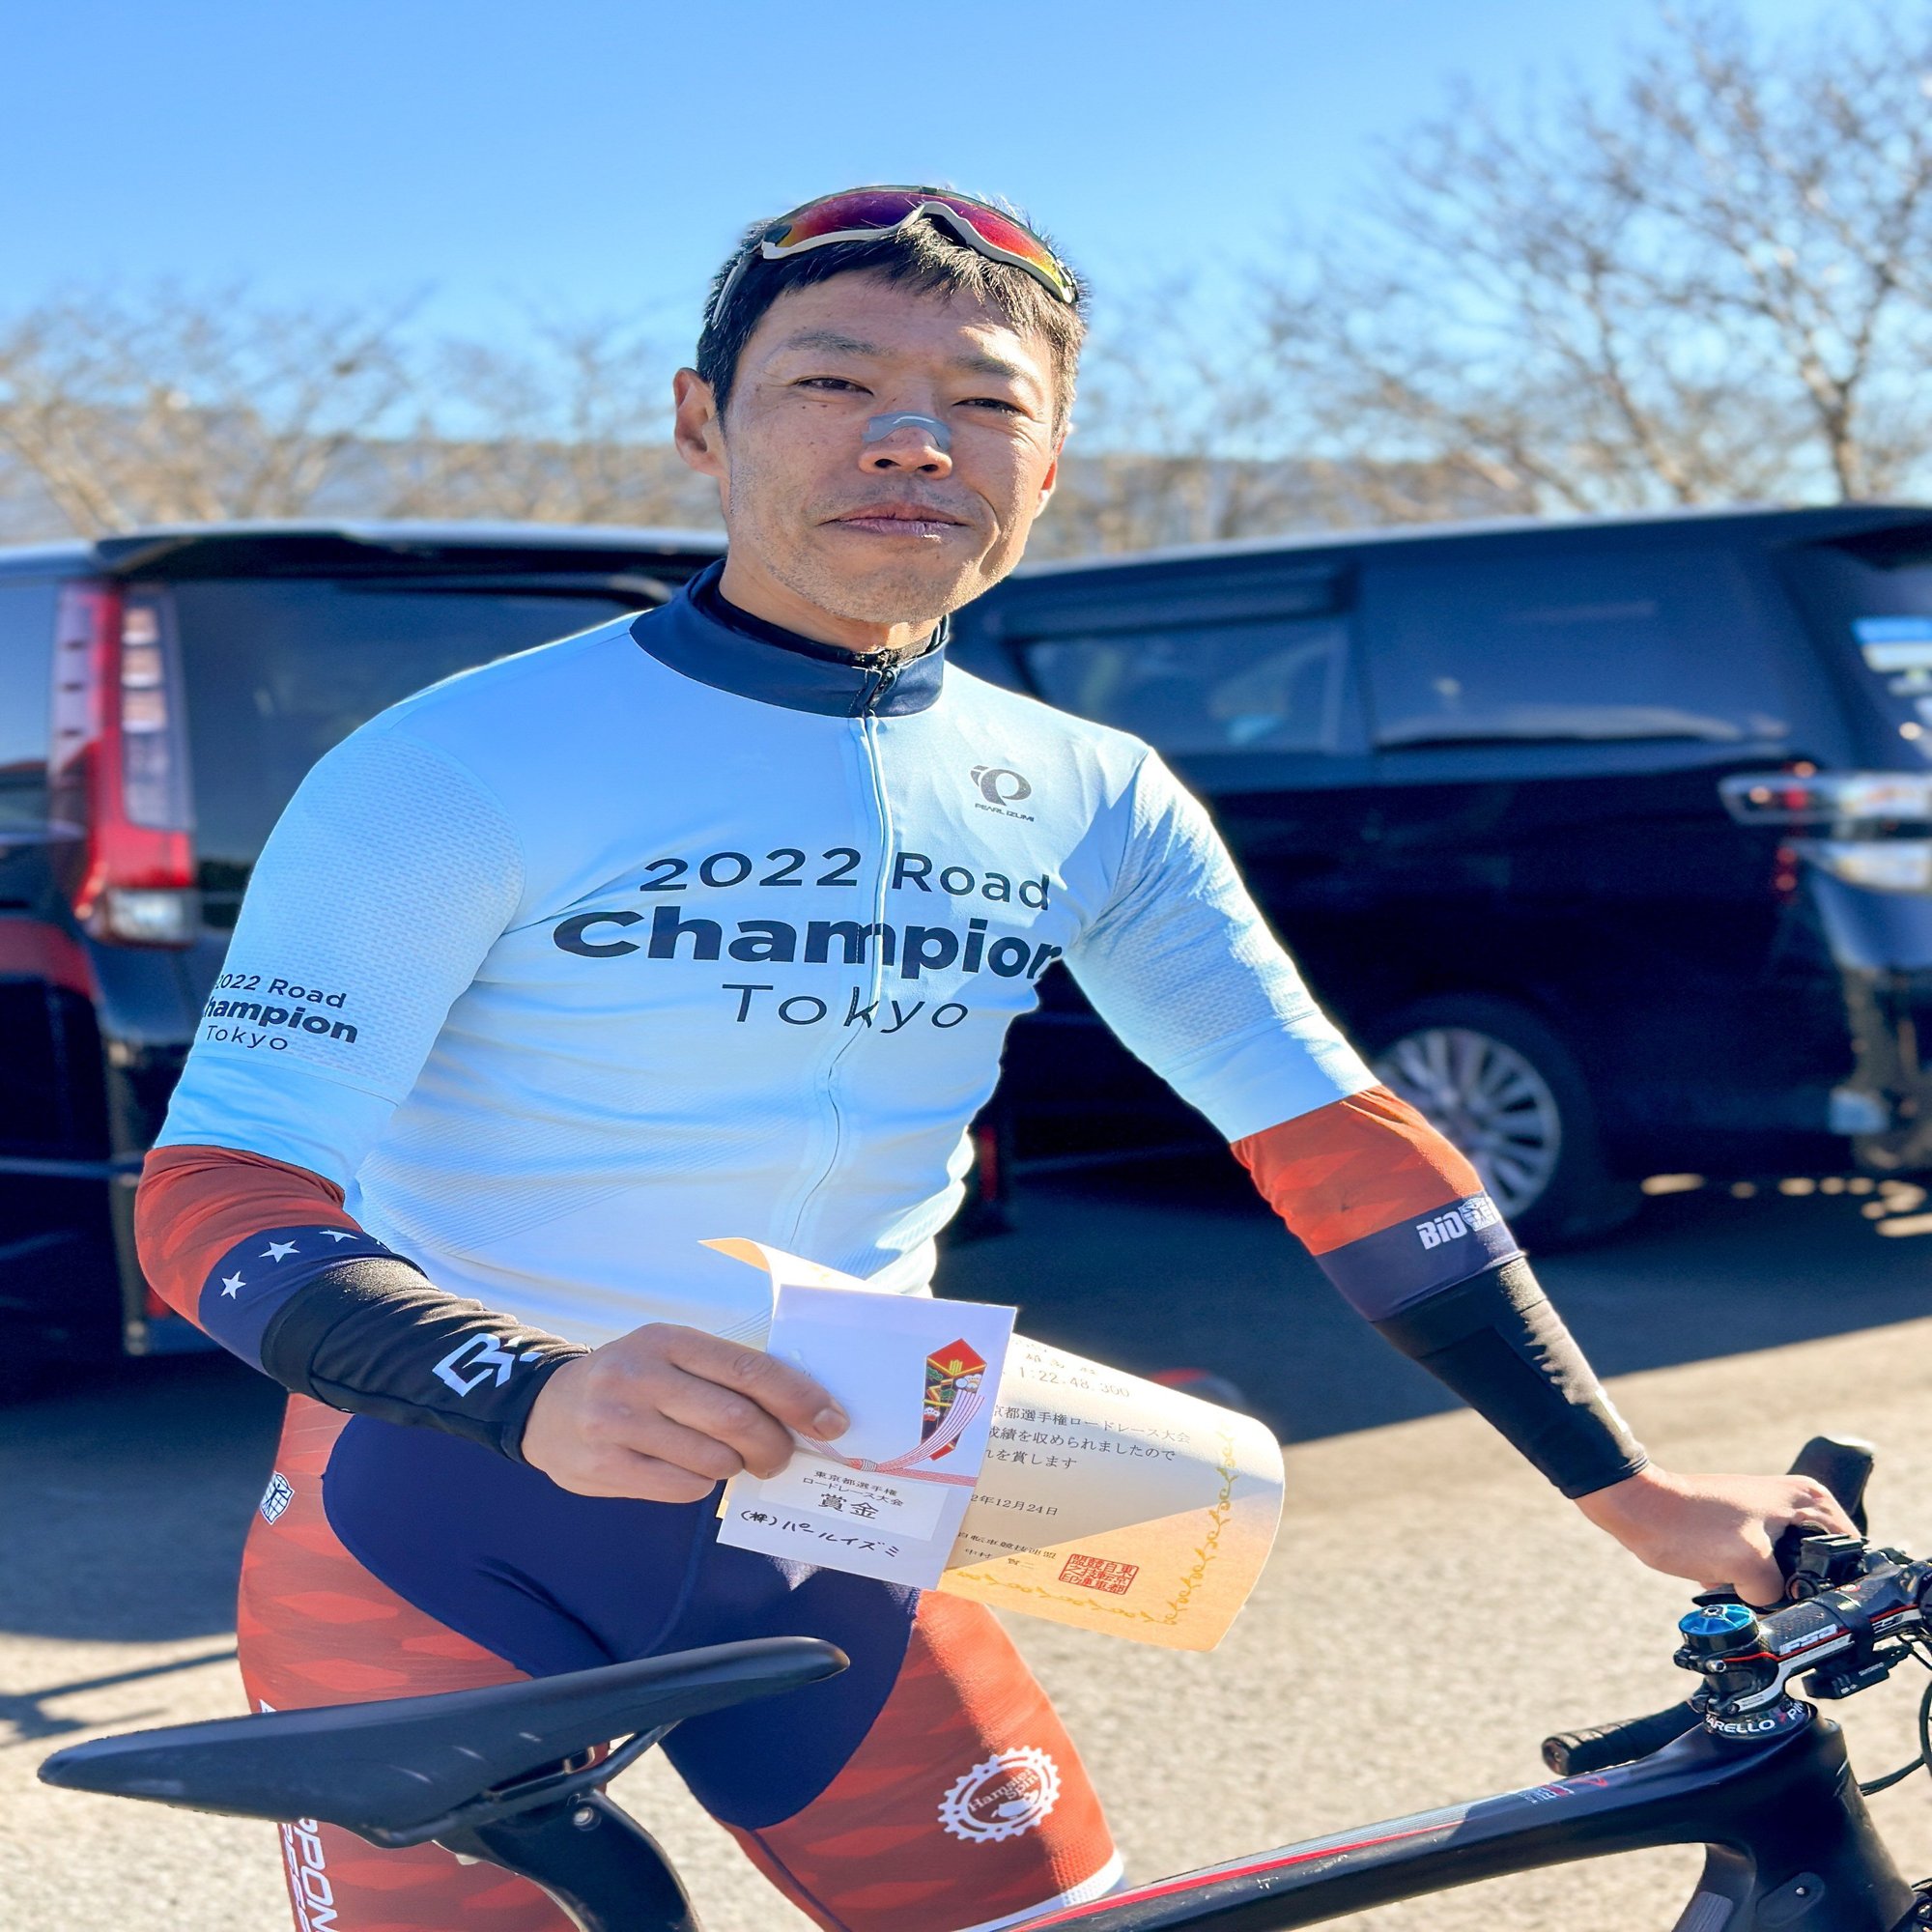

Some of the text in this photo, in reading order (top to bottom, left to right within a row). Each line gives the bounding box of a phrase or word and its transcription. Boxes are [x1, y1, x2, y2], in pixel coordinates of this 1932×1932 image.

[975, 803, 1005, 814] PEARL
[639, 847, 1050, 911] 2022 Road
[268, 979, 347, 1009] Road
[722, 983, 968, 1034] Tokyo
[204, 996, 358, 1044] hampion
[206, 1025, 288, 1050] Tokyo
[803, 1477, 905, 1507] ロードレース大会
[813, 1469, 898, 1496] 東京都選手権
[818, 1492, 879, 1520] 賞金
[970, 1494, 1059, 1516] 2年12月24日
